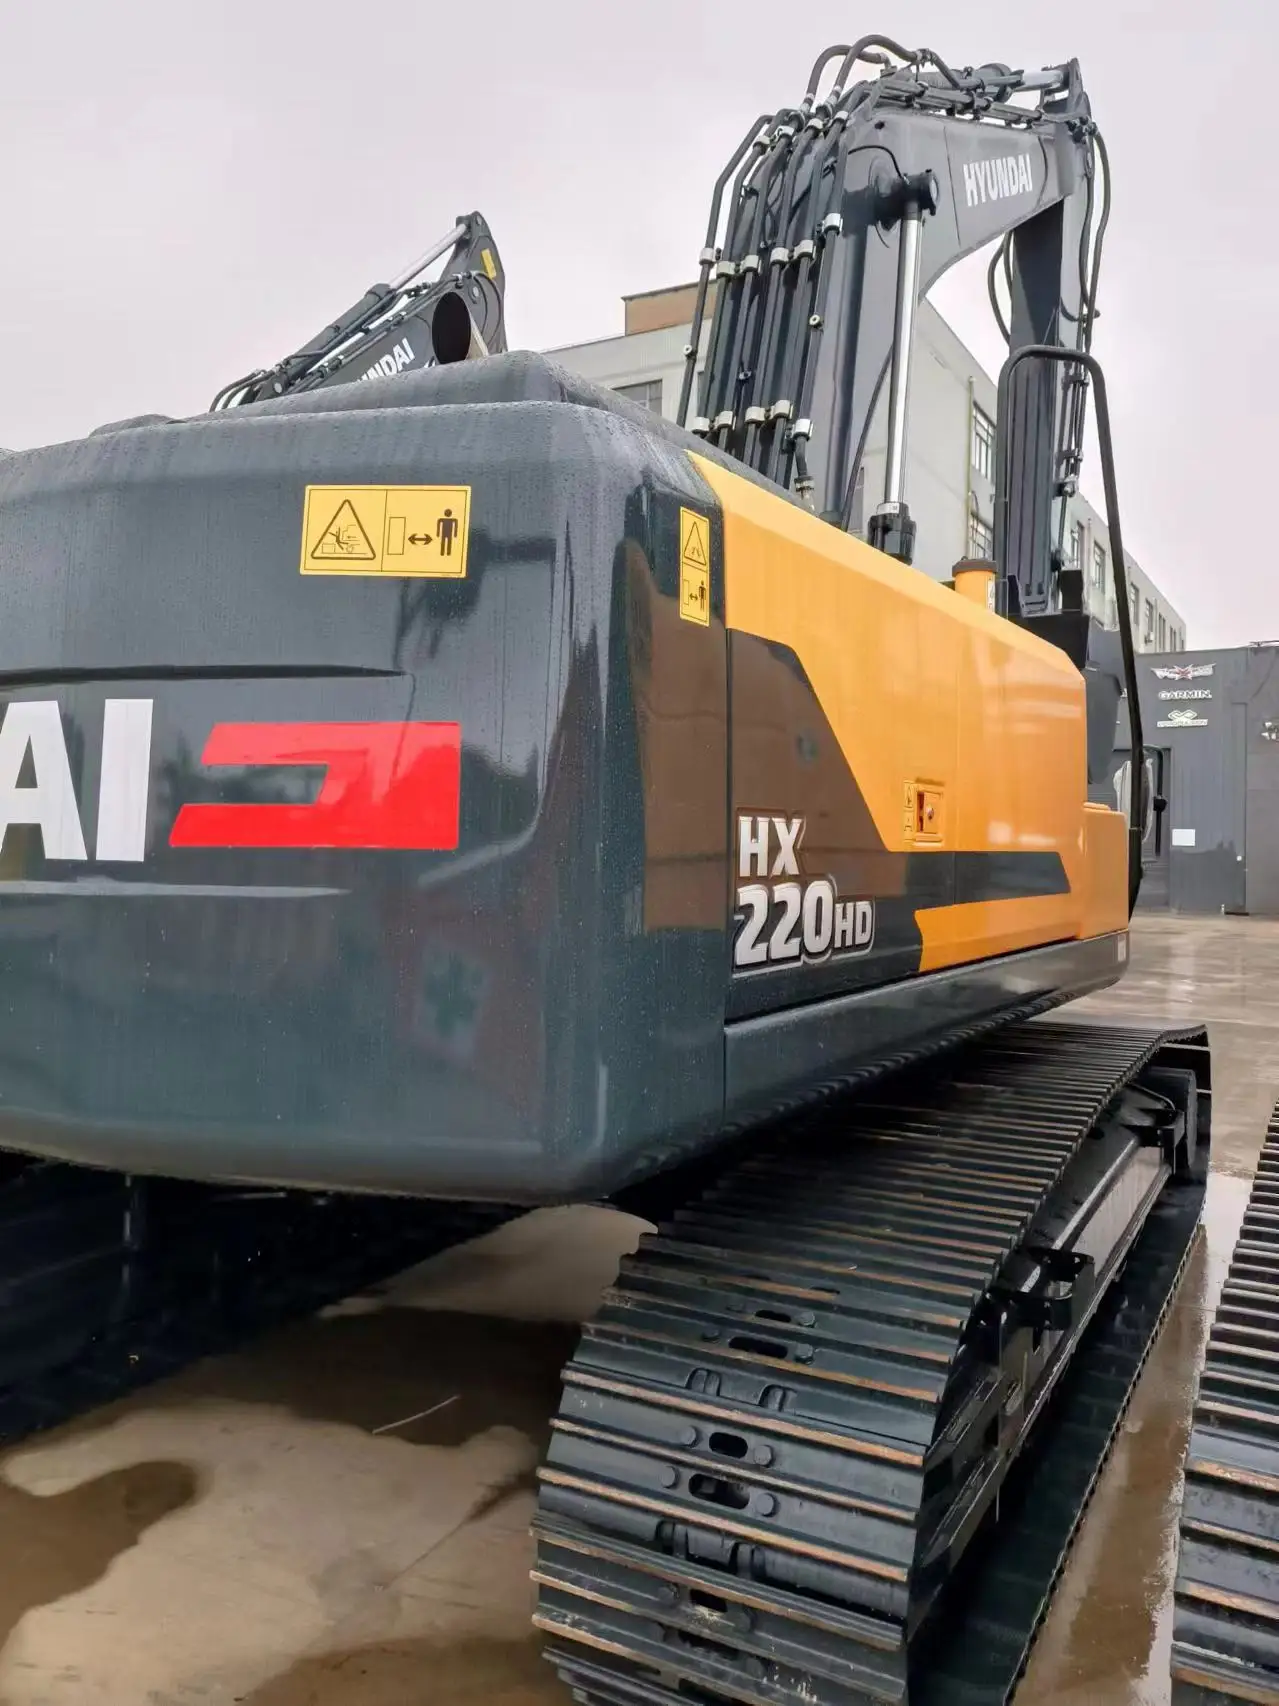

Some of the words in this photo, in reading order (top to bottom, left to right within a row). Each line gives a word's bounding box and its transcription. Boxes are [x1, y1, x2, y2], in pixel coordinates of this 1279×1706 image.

[963, 153, 1033, 207] HYUNDAI
[0, 698, 154, 862] AI
[738, 815, 803, 878] HX
